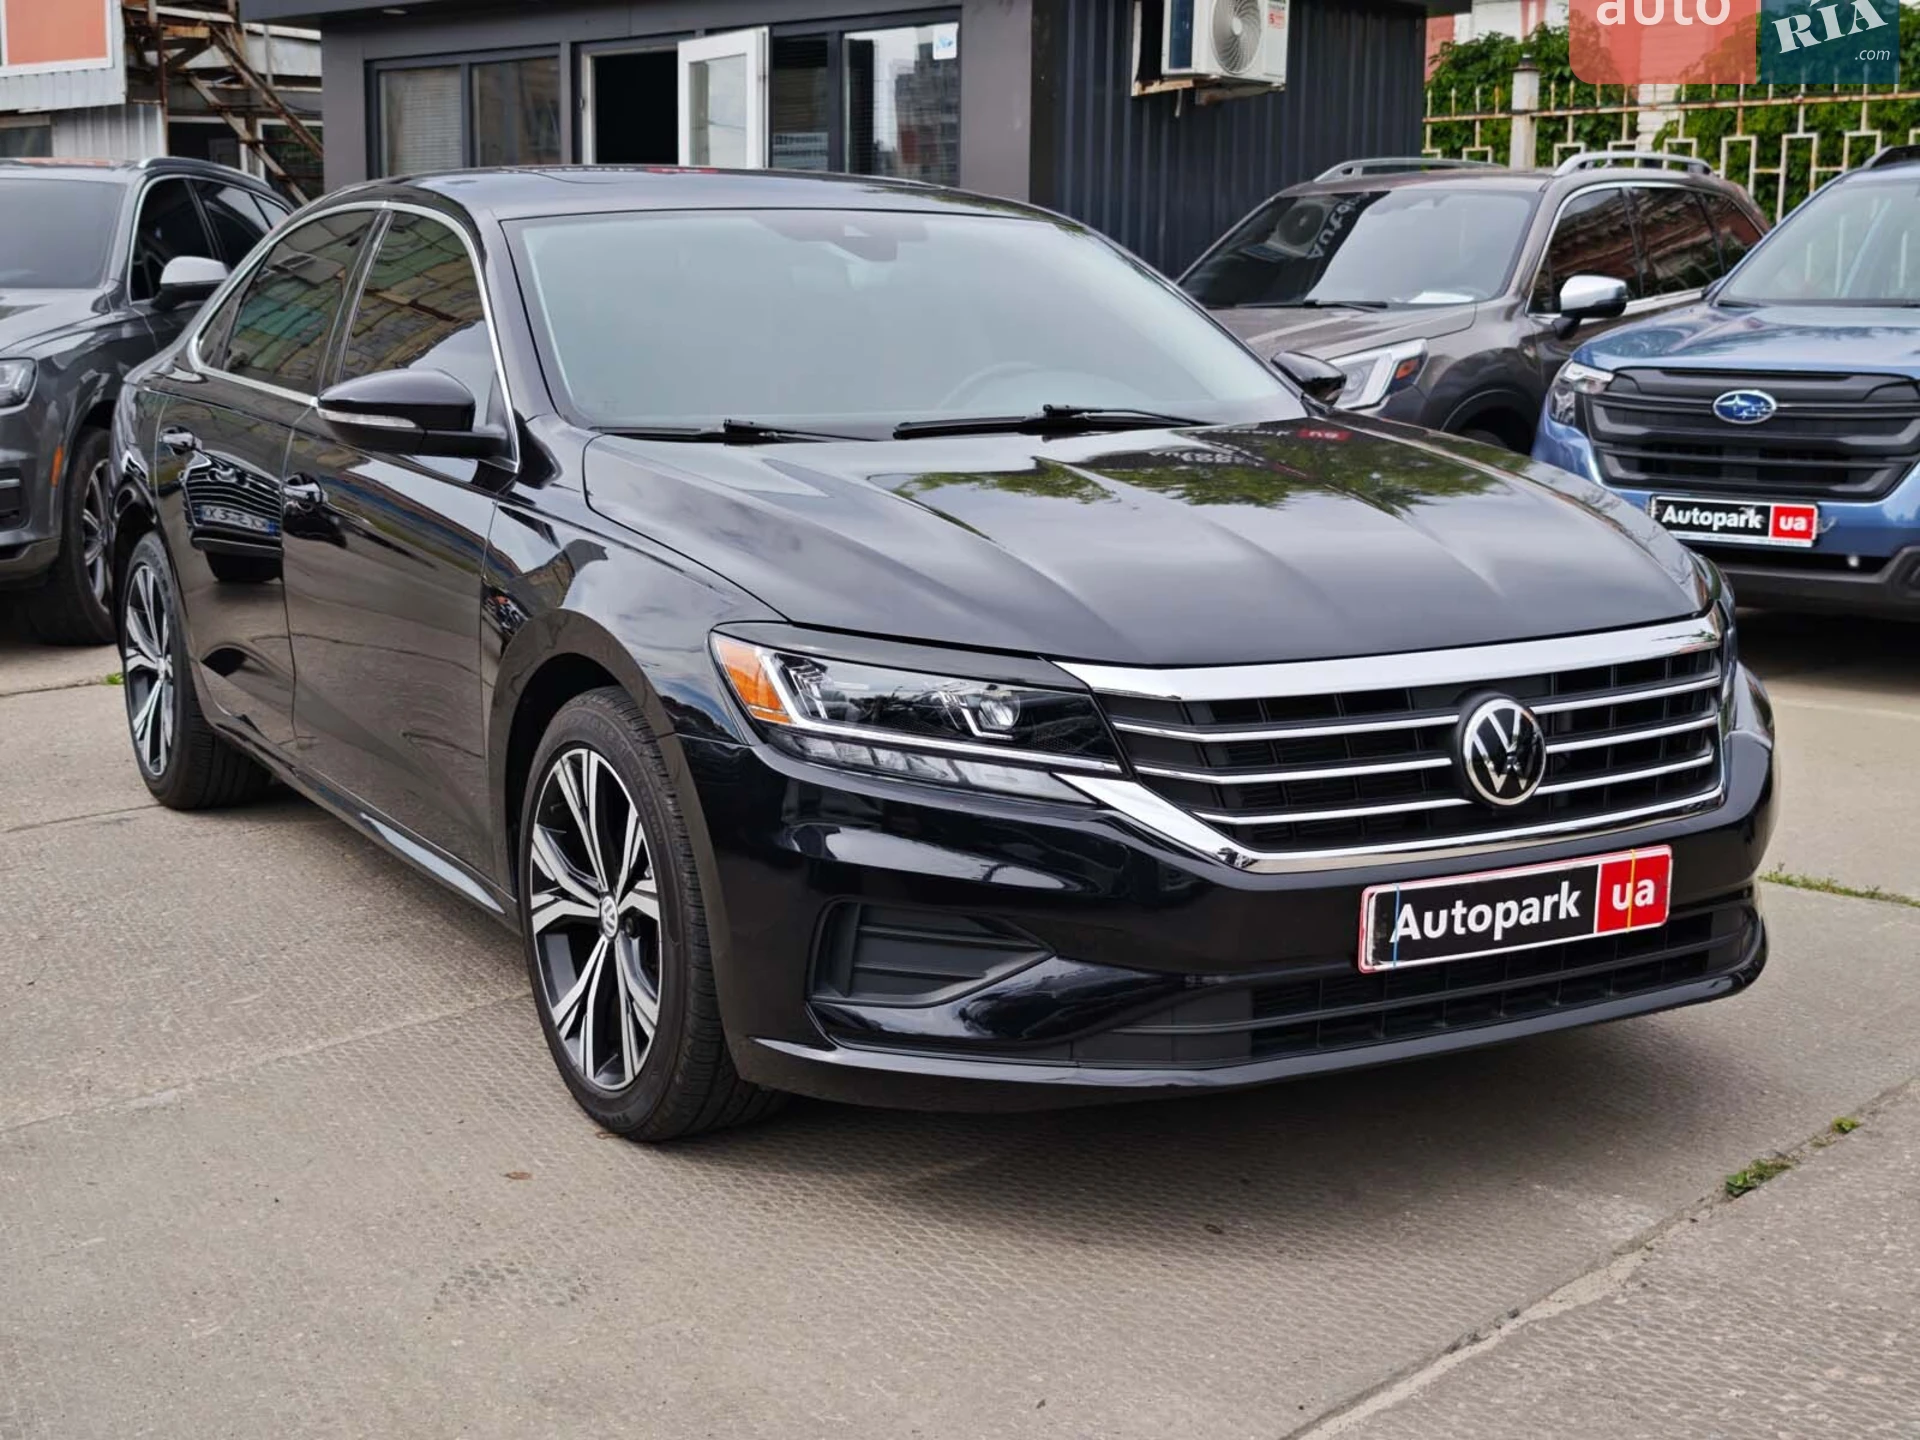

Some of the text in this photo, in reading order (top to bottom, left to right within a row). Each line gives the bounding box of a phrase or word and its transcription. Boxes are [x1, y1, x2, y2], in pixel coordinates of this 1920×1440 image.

[1661, 504, 1808, 532] Autopark ua
[1389, 878, 1655, 942] Autopark ua
